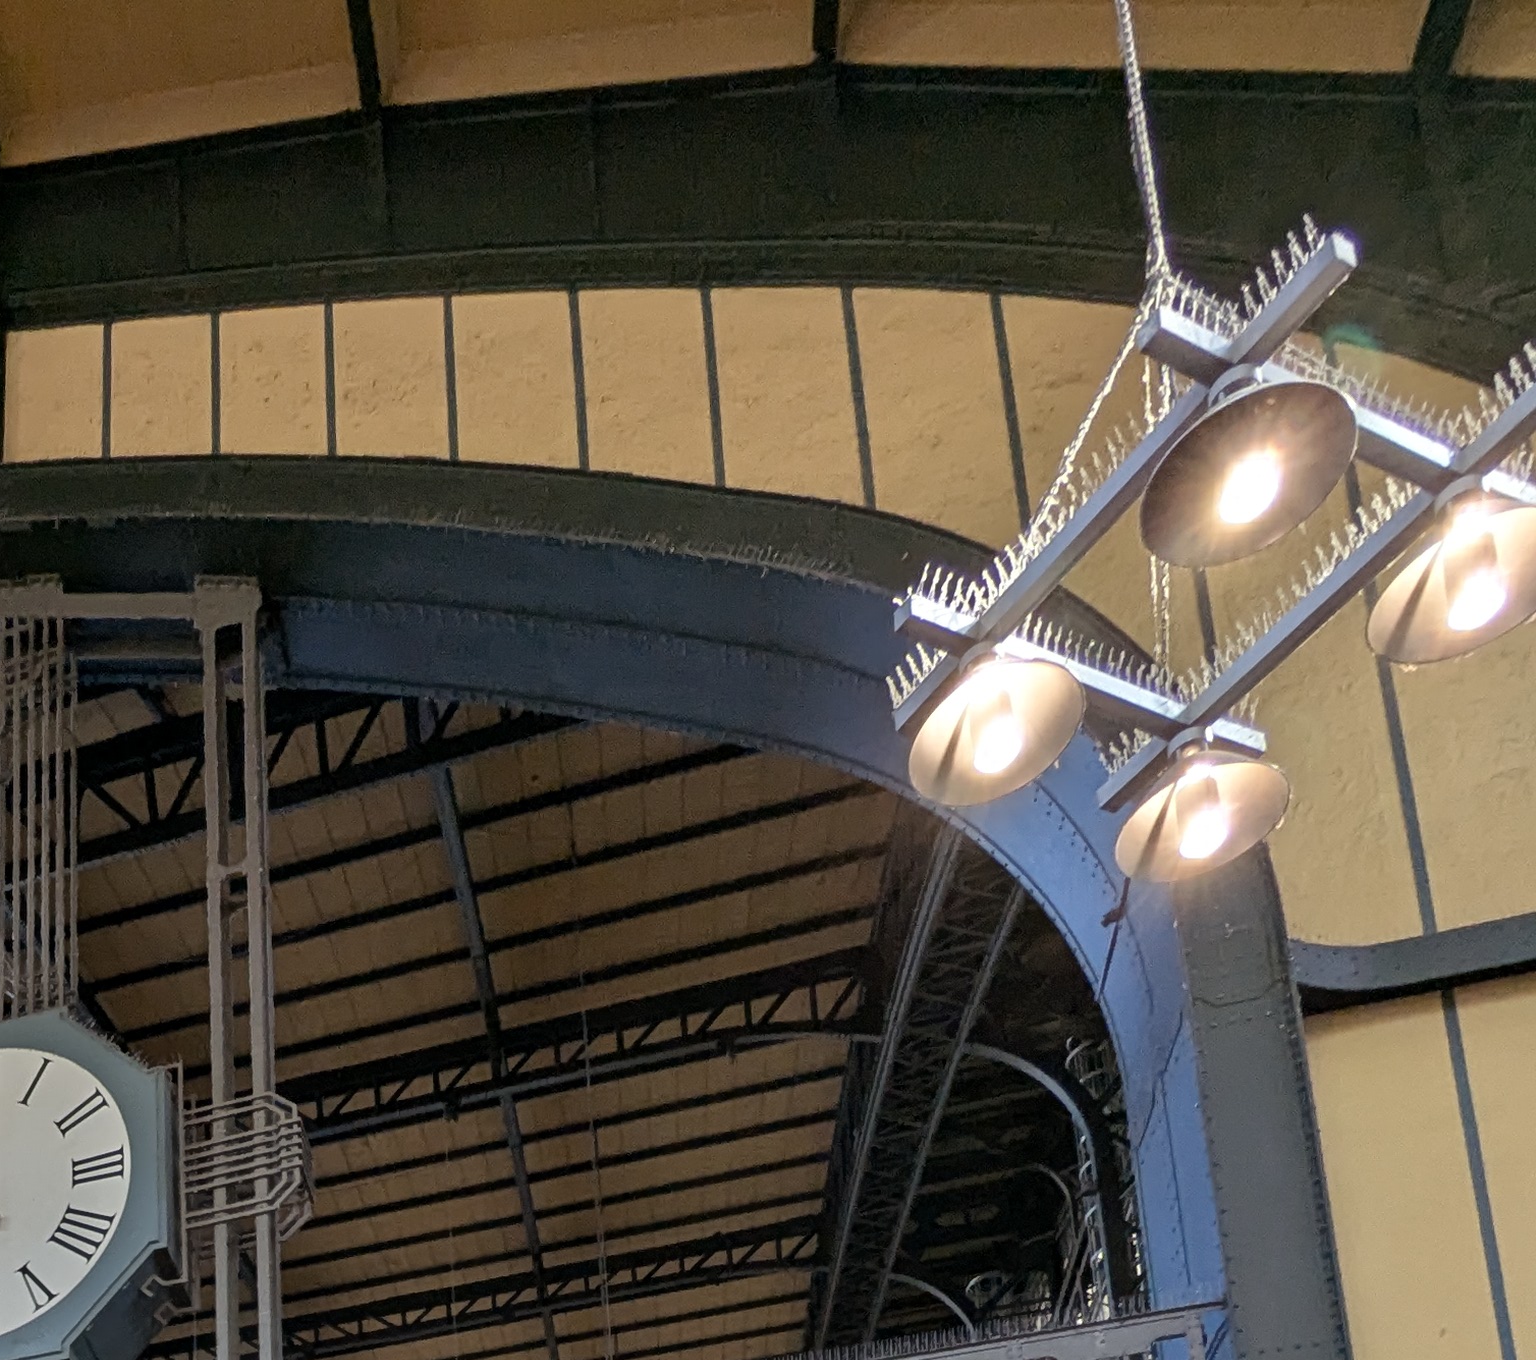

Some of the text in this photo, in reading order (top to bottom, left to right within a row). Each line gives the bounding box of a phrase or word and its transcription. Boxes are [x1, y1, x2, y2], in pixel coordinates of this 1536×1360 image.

[17, 1057, 53, 1106] I
[53, 1087, 110, 1138] II
[71, 1144, 125, 1188] III
[46, 1203, 117, 1265] IIII
[14, 1260, 60, 1314] V
